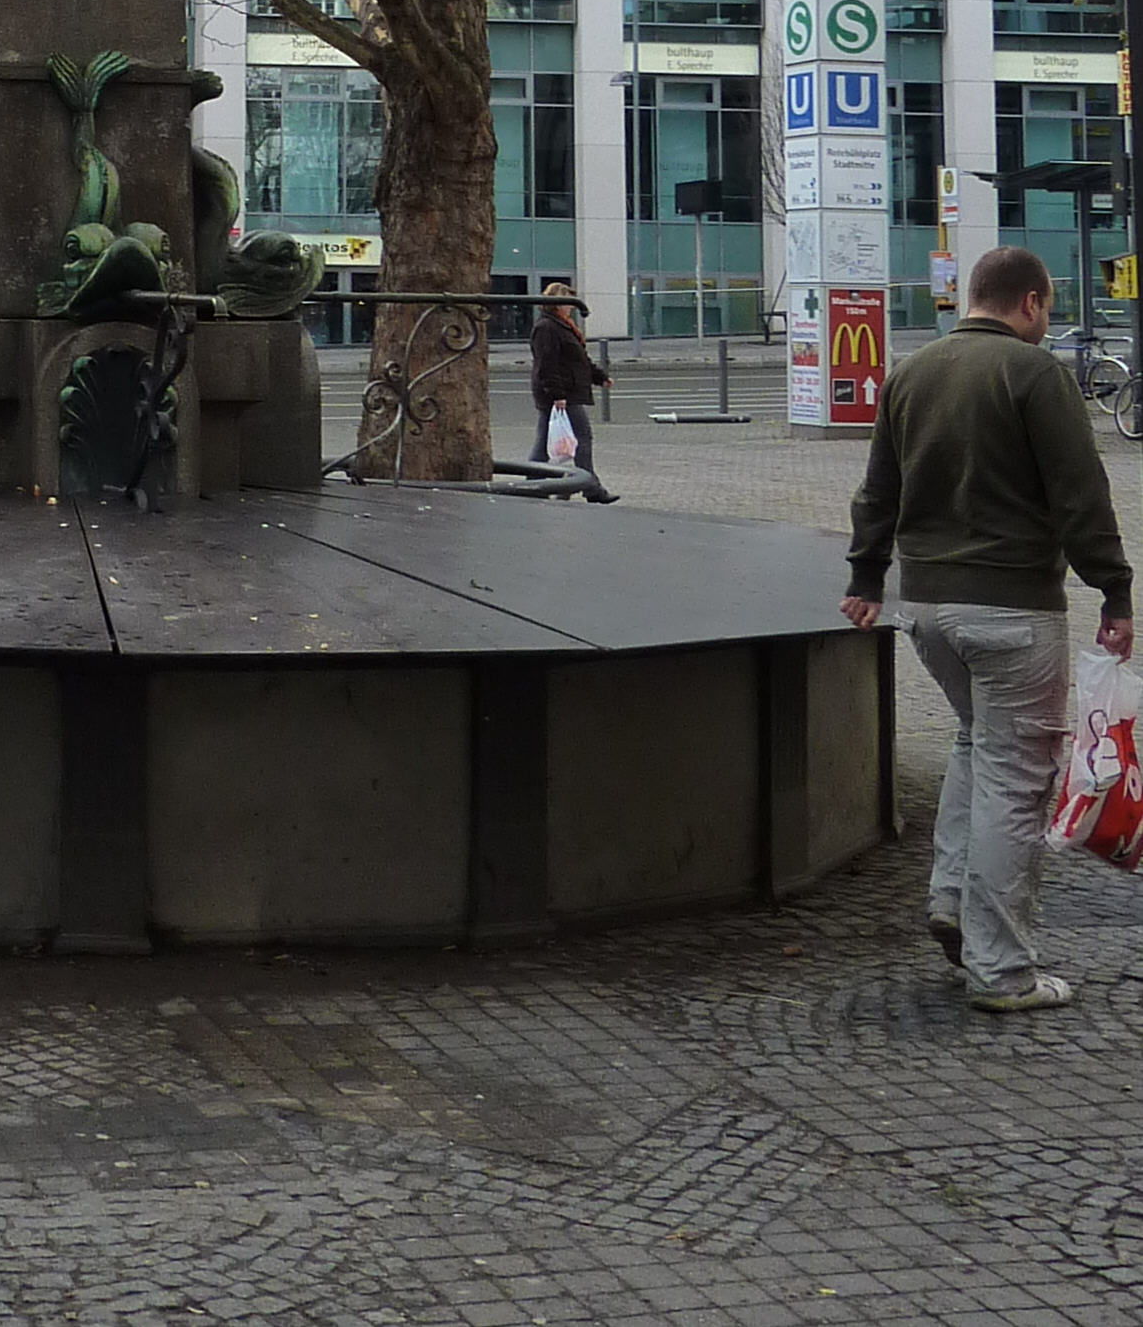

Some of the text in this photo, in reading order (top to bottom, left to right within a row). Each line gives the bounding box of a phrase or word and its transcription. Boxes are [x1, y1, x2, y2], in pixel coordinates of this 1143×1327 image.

[791, 6, 808, 51] S
[836, 3, 869, 49] S
[667, 47, 714, 60] bulthaup
[1033, 55, 1079, 67] bulthaup
[791, 75, 809, 115] U
[836, 75, 870, 114] U
